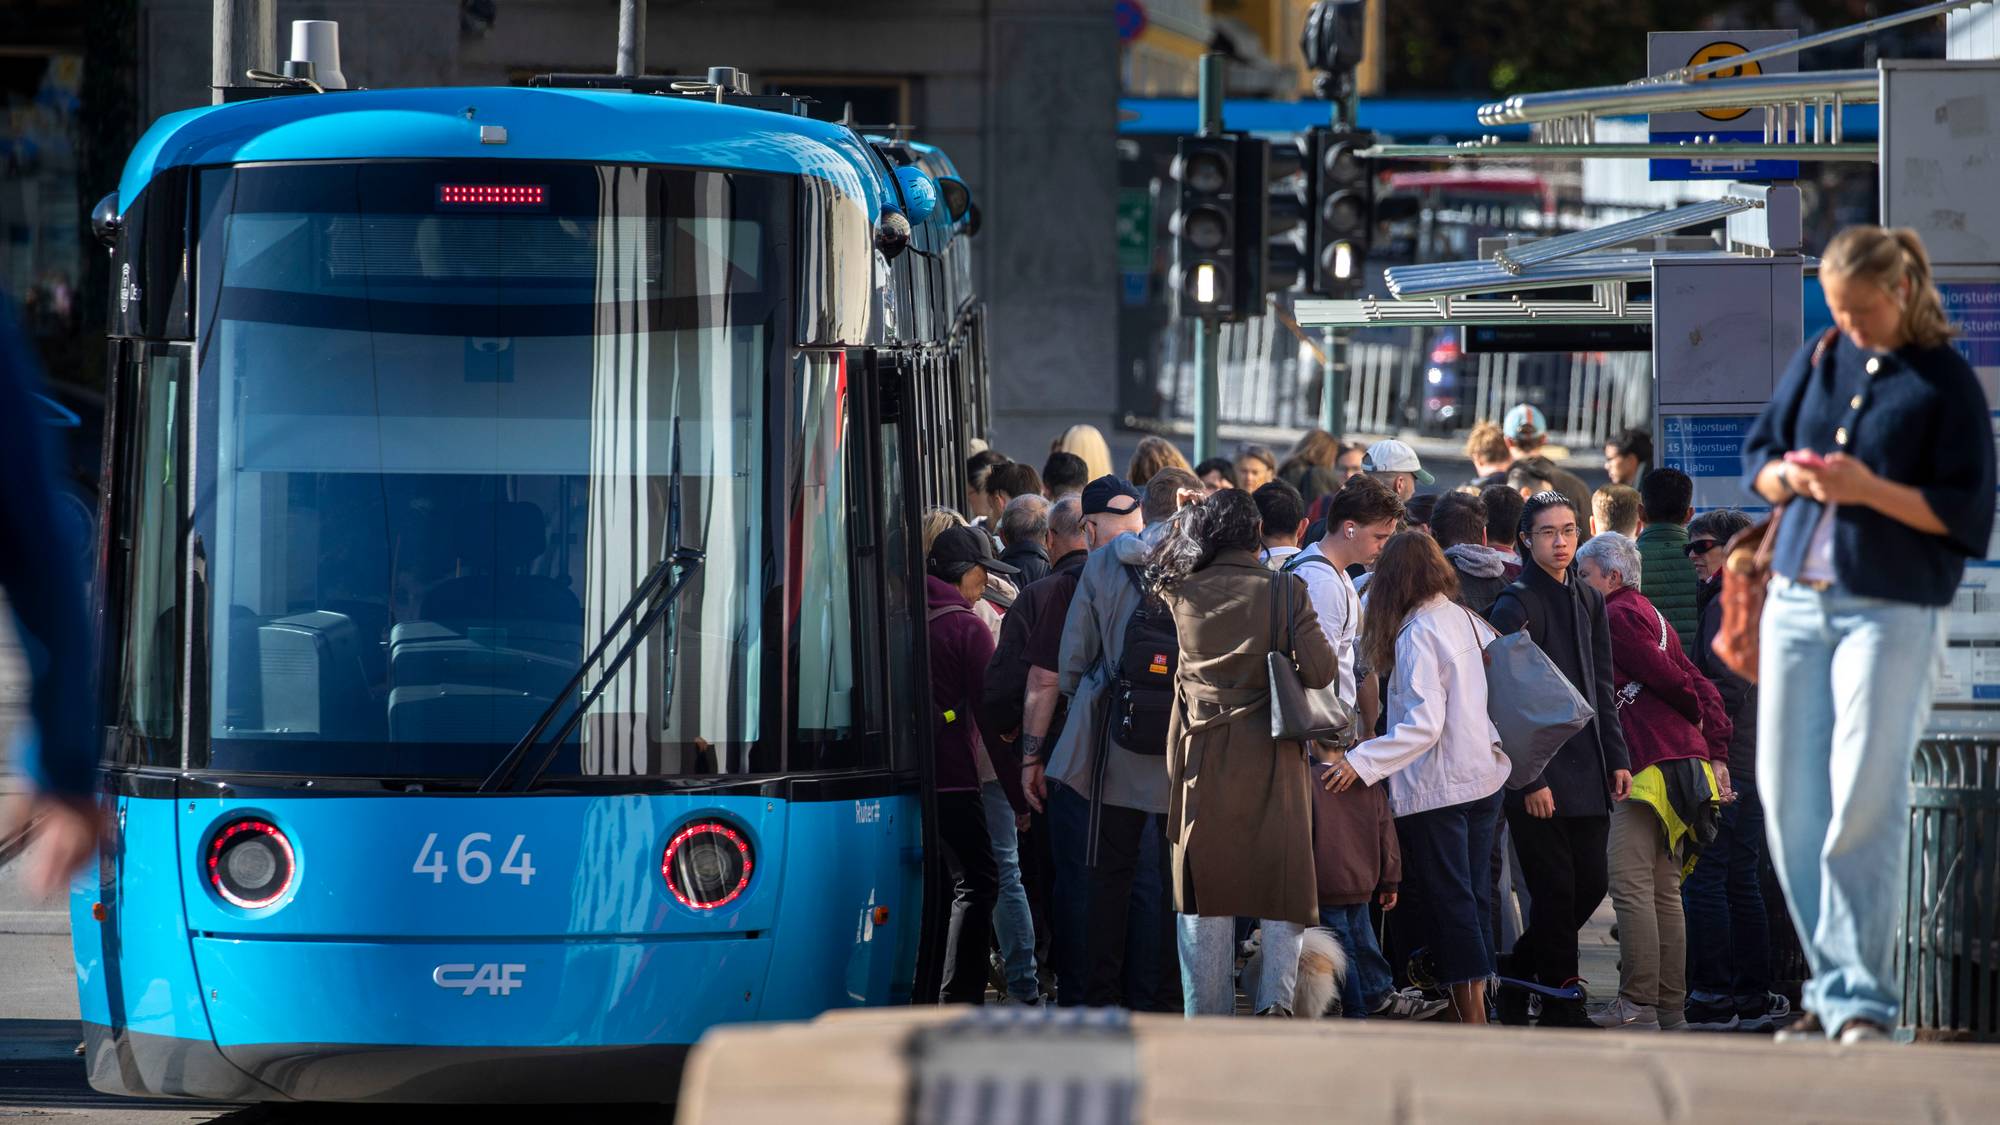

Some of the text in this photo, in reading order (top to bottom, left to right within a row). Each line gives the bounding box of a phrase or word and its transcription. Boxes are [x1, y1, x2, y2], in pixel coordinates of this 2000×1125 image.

[1667, 423, 1737, 433] 12 Majorstuen
[1667, 442, 1738, 453] 15 Majorstuen
[1684, 463, 1715, 473] Ljabru
[412, 831, 537, 886] 464
[432, 963, 526, 996] CAF
